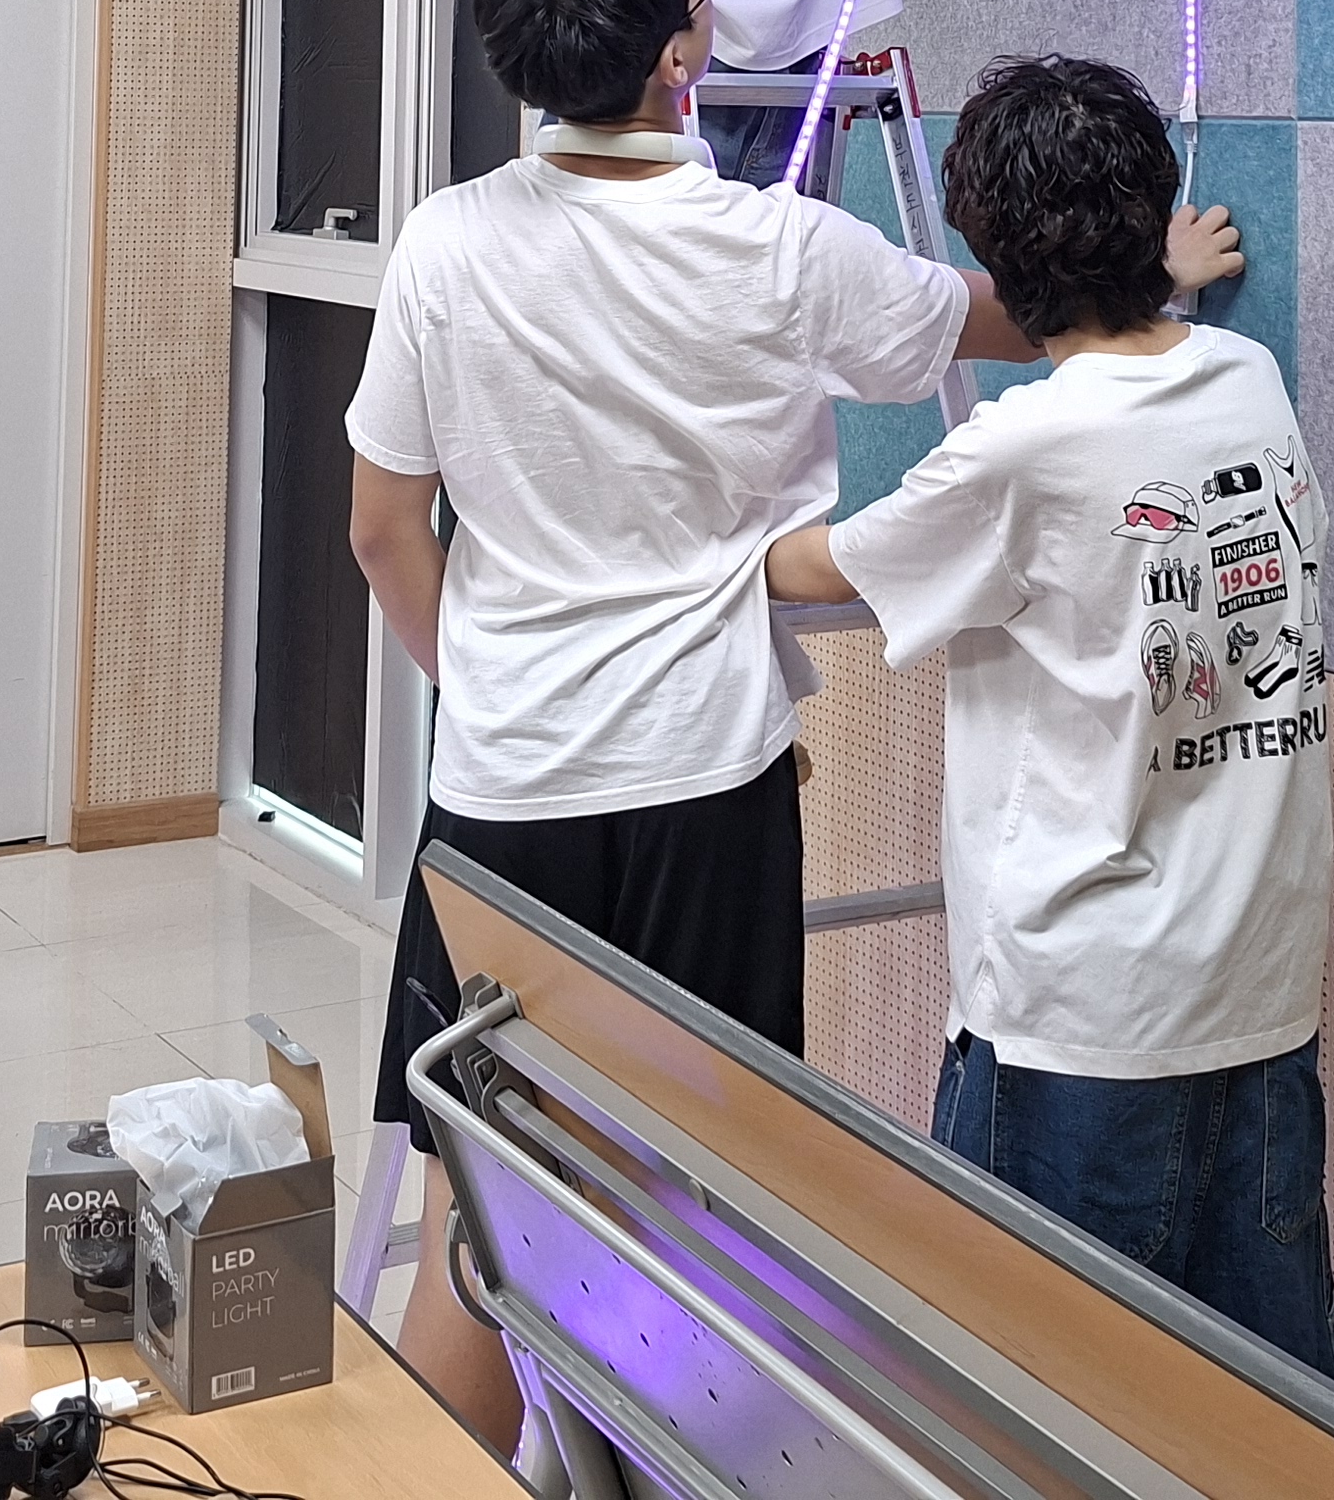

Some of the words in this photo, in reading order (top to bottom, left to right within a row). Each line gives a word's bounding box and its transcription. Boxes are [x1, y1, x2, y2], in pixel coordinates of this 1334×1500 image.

[1214, 534, 1278, 566] FINISHER
[1219, 557, 1281, 597] 1906
[1220, 604, 1228, 616] A
[1228, 593, 1262, 612] BETTER
[1263, 587, 1286, 602] RUN
[44, 1188, 121, 1213] AORA
[140, 1205, 167, 1248] AORA
[212, 1247, 256, 1275] LED
[212, 1267, 280, 1302] PARTY
[212, 1296, 276, 1329] LIGHT
